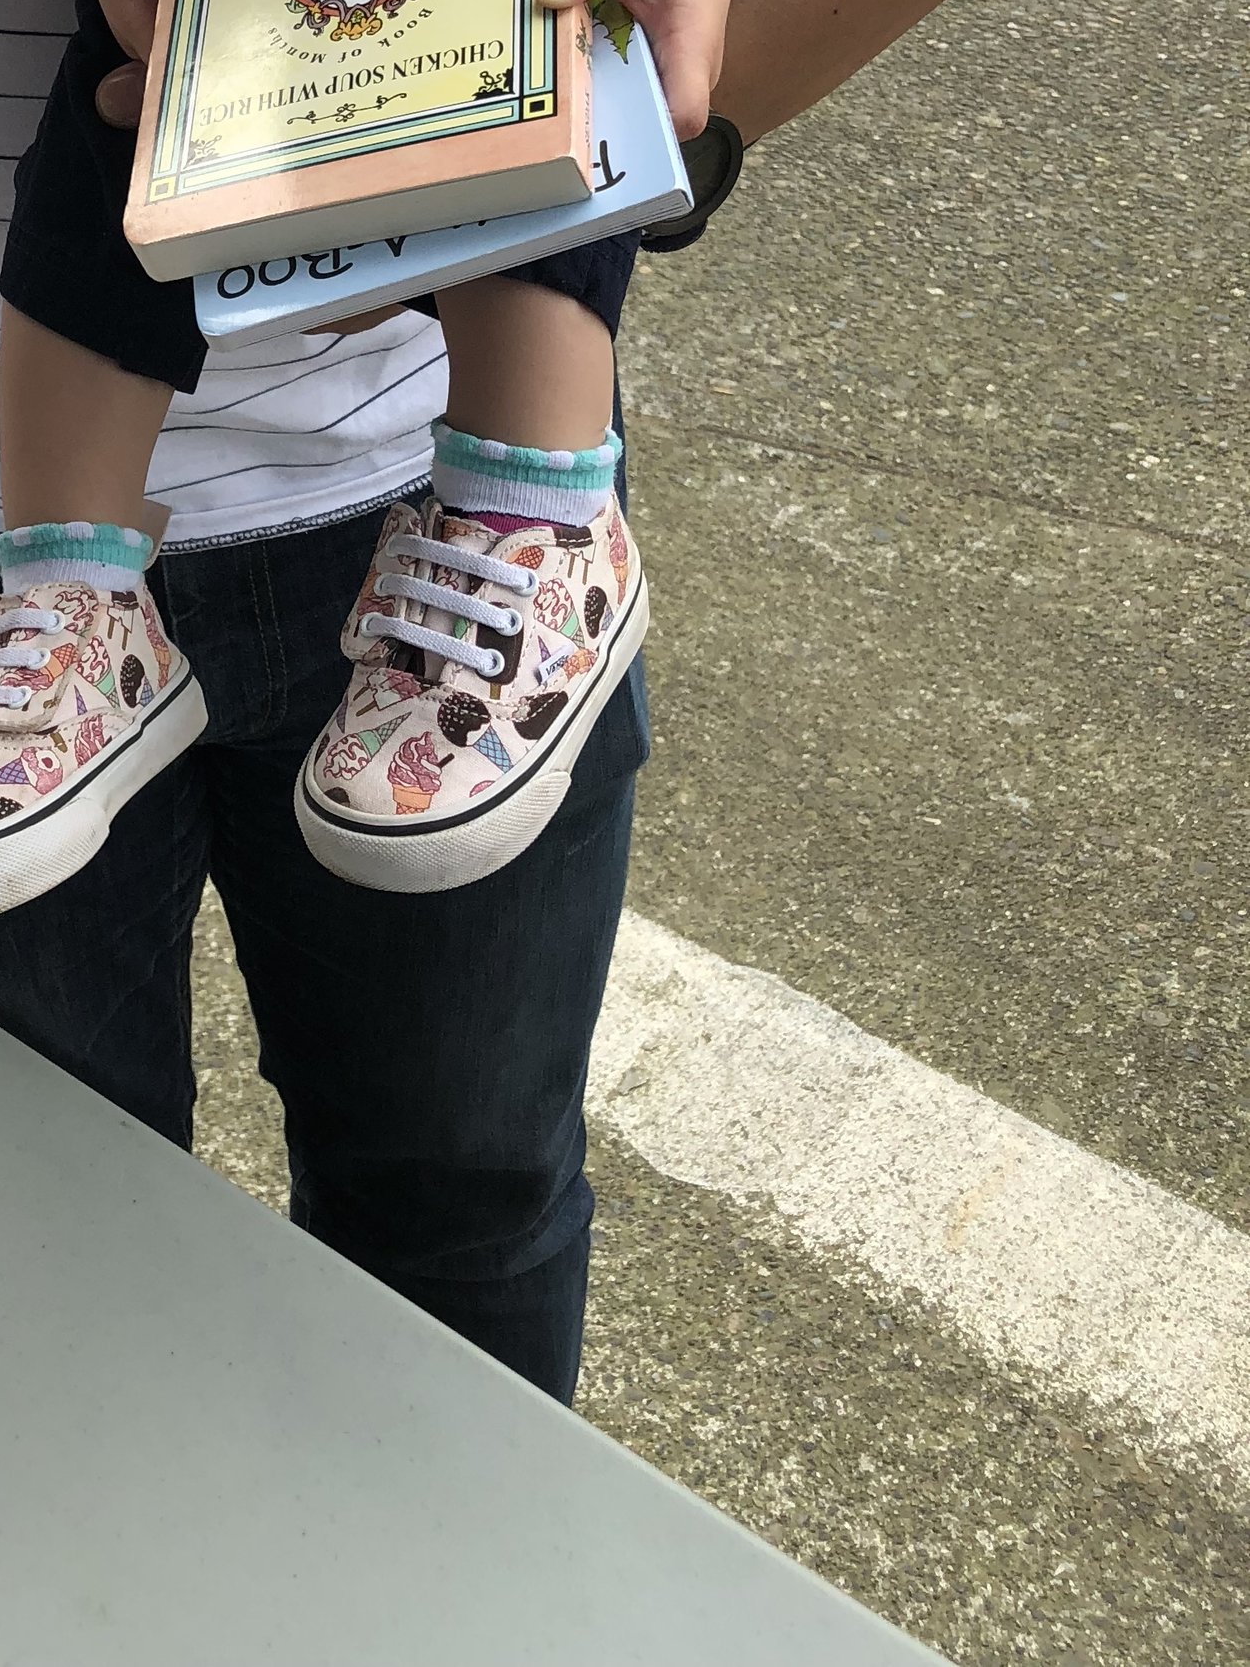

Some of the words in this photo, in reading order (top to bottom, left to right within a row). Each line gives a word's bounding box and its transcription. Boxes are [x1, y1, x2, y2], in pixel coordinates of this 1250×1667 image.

[392, 39, 505, 82] CHICKEN
[258, 80, 318, 111] WITH
[325, 65, 385, 97] SOUP
[199, 96, 252, 128] RICE
